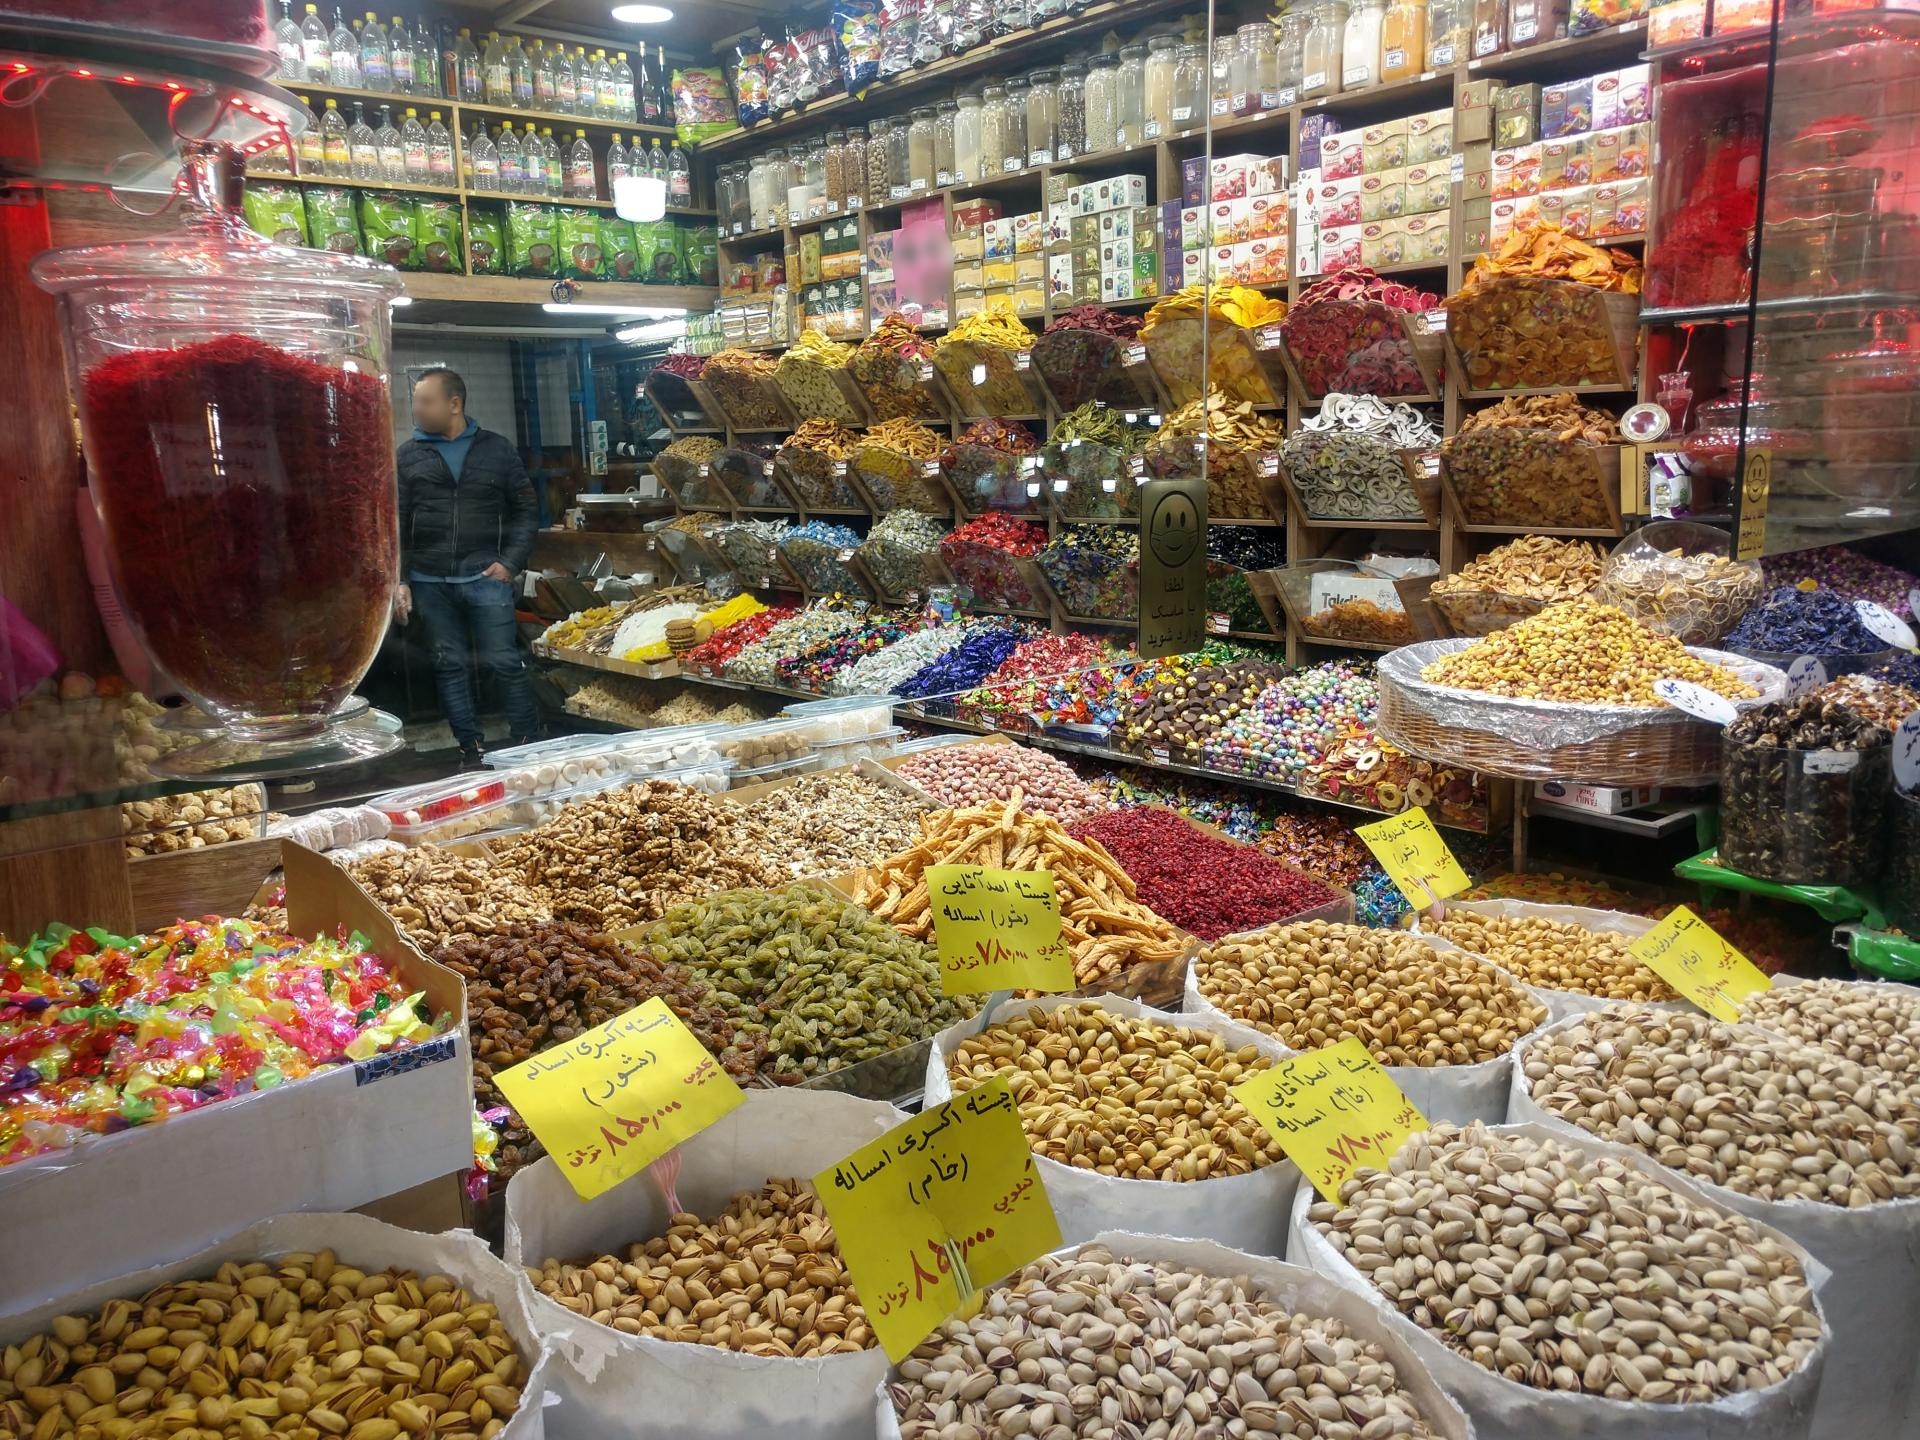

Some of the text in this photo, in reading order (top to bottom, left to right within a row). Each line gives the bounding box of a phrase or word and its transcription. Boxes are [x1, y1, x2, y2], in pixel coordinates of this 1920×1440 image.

[1015, 879, 1052, 910] پسته
[943, 904, 1029, 929] (شور) امساله
[624, 1010, 674, 1034] پسته
[576, 1017, 626, 1060] اکبری
[582, 1050, 657, 1107] (شور)
[1336, 1056, 1380, 1078] پسته
[1276, 1108, 1327, 1133] امساله
[834, 1090, 1012, 1191] پسته اکبری امساله
[908, 1152, 968, 1205] (خام)
